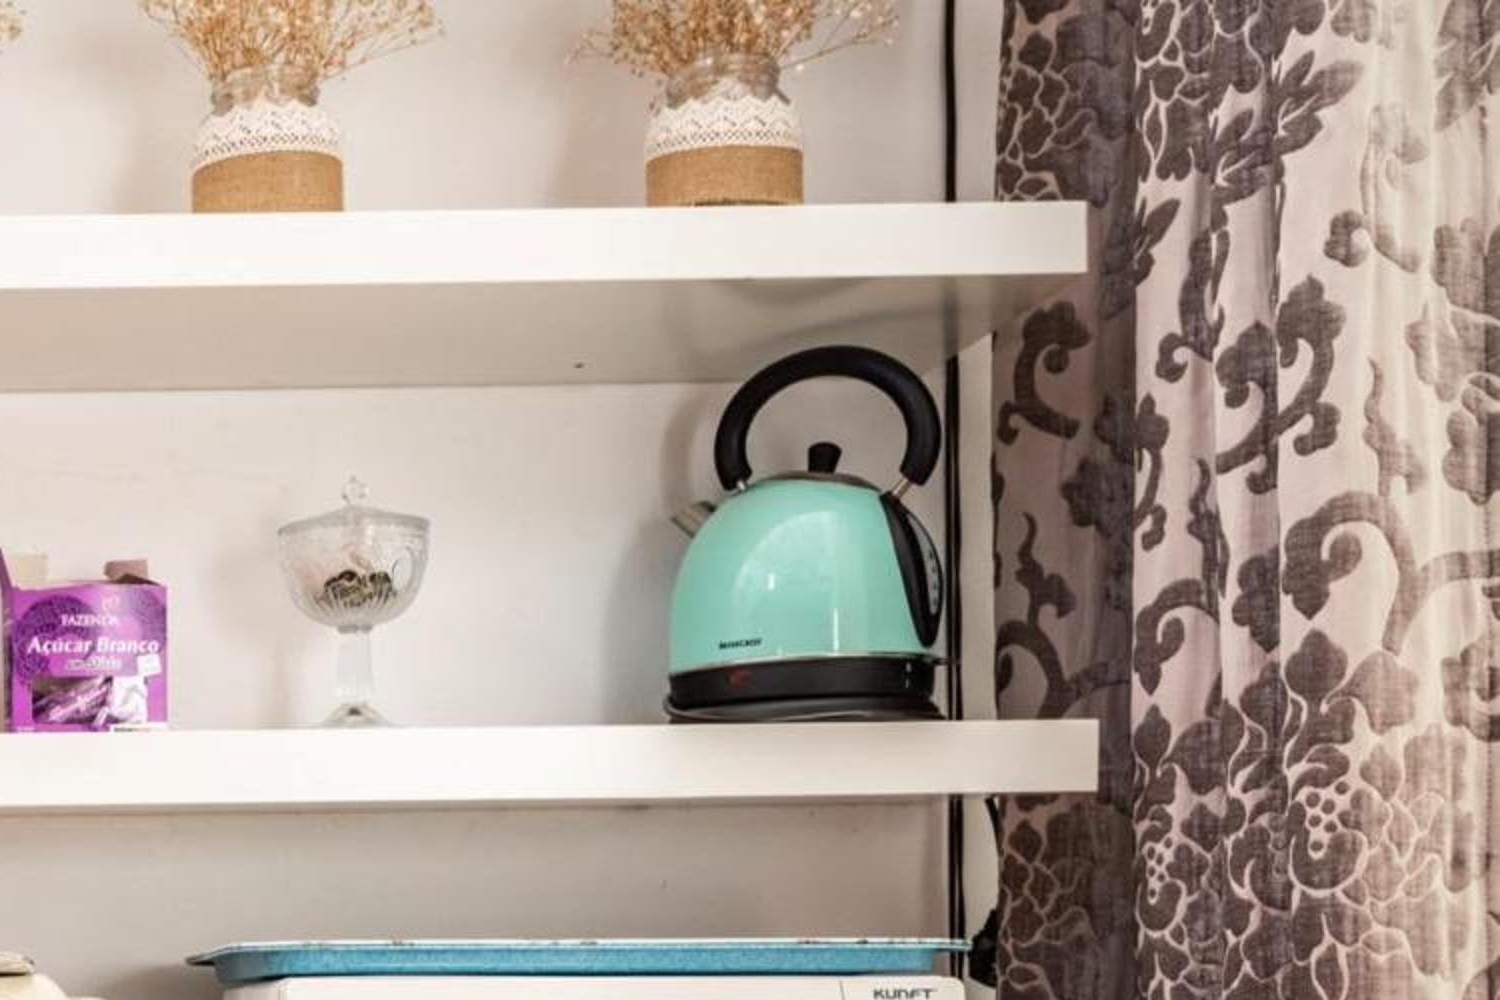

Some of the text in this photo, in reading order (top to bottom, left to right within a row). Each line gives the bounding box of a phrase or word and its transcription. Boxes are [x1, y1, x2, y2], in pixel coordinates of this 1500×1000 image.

[27, 636, 160, 655] Açúcar Branco
[873, 988, 936, 1000] KUNFT
